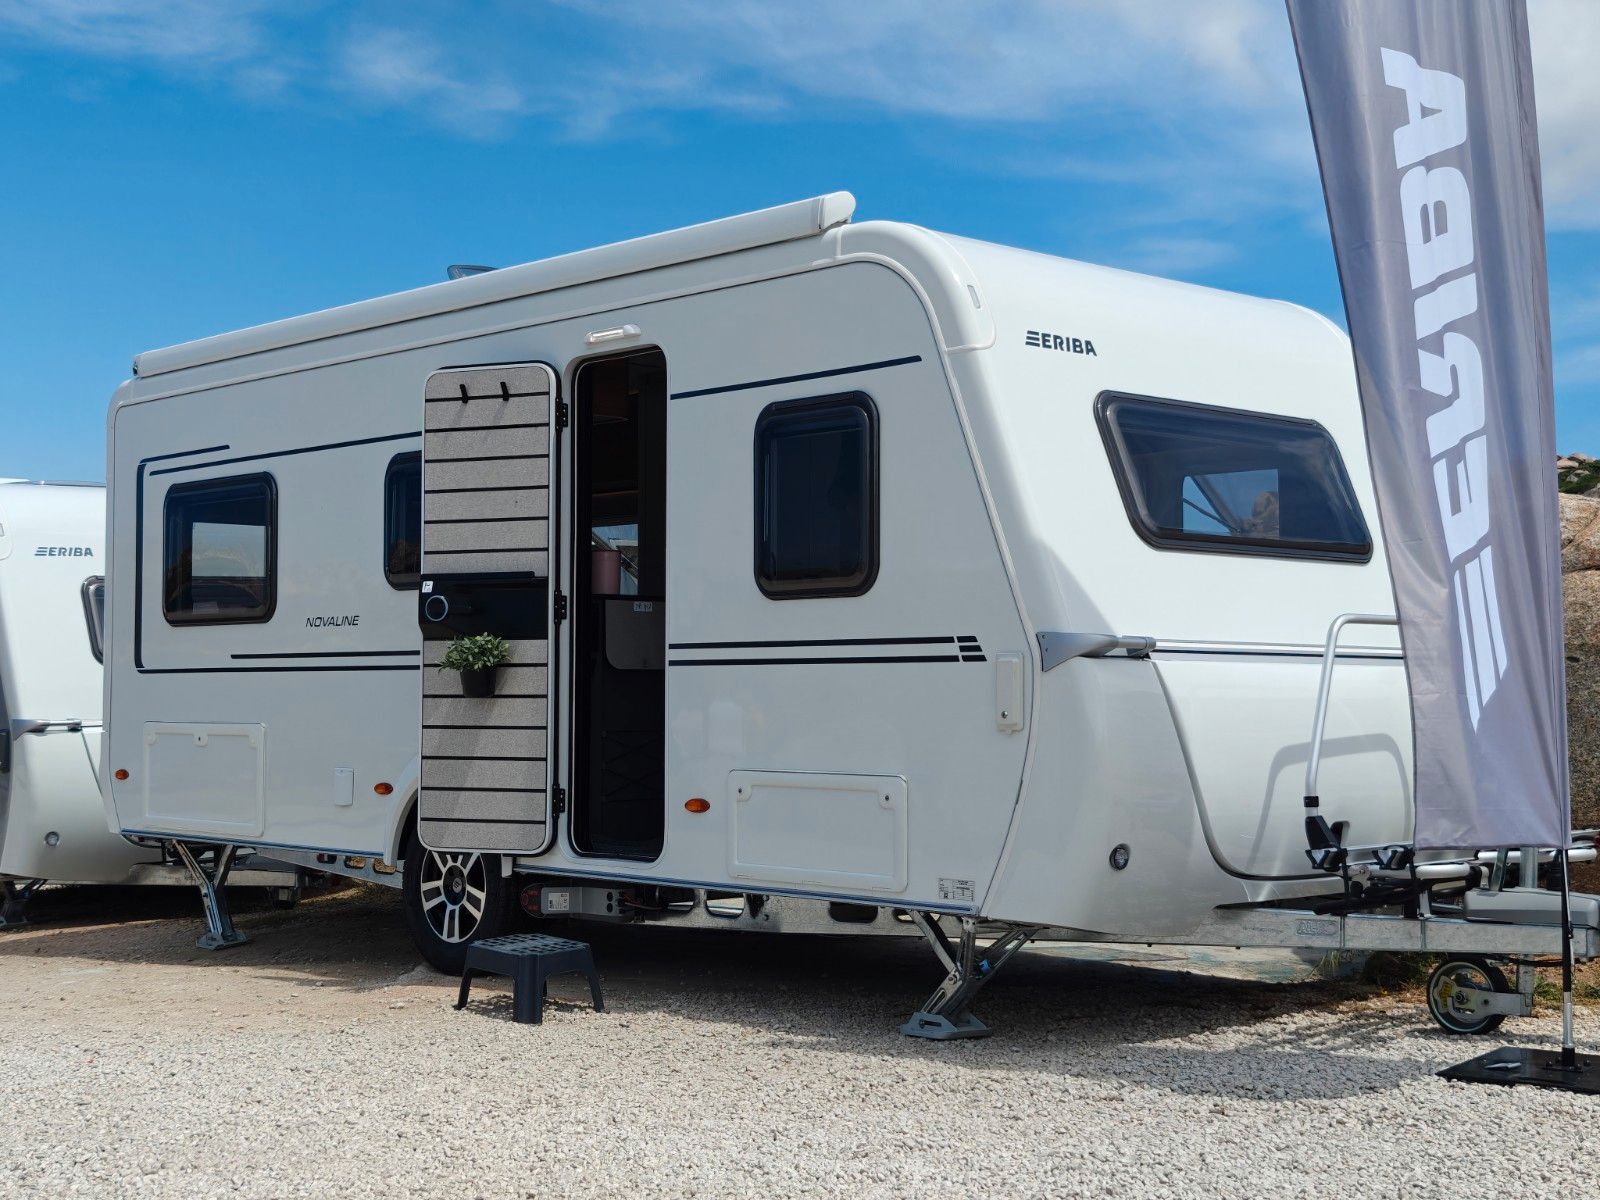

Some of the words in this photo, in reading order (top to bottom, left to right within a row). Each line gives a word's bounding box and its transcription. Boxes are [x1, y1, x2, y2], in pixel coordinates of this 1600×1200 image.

[1041, 332, 1097, 357] ERIBA
[48, 546, 94, 557] ERIBA
[305, 615, 360, 628] NOVALINE
